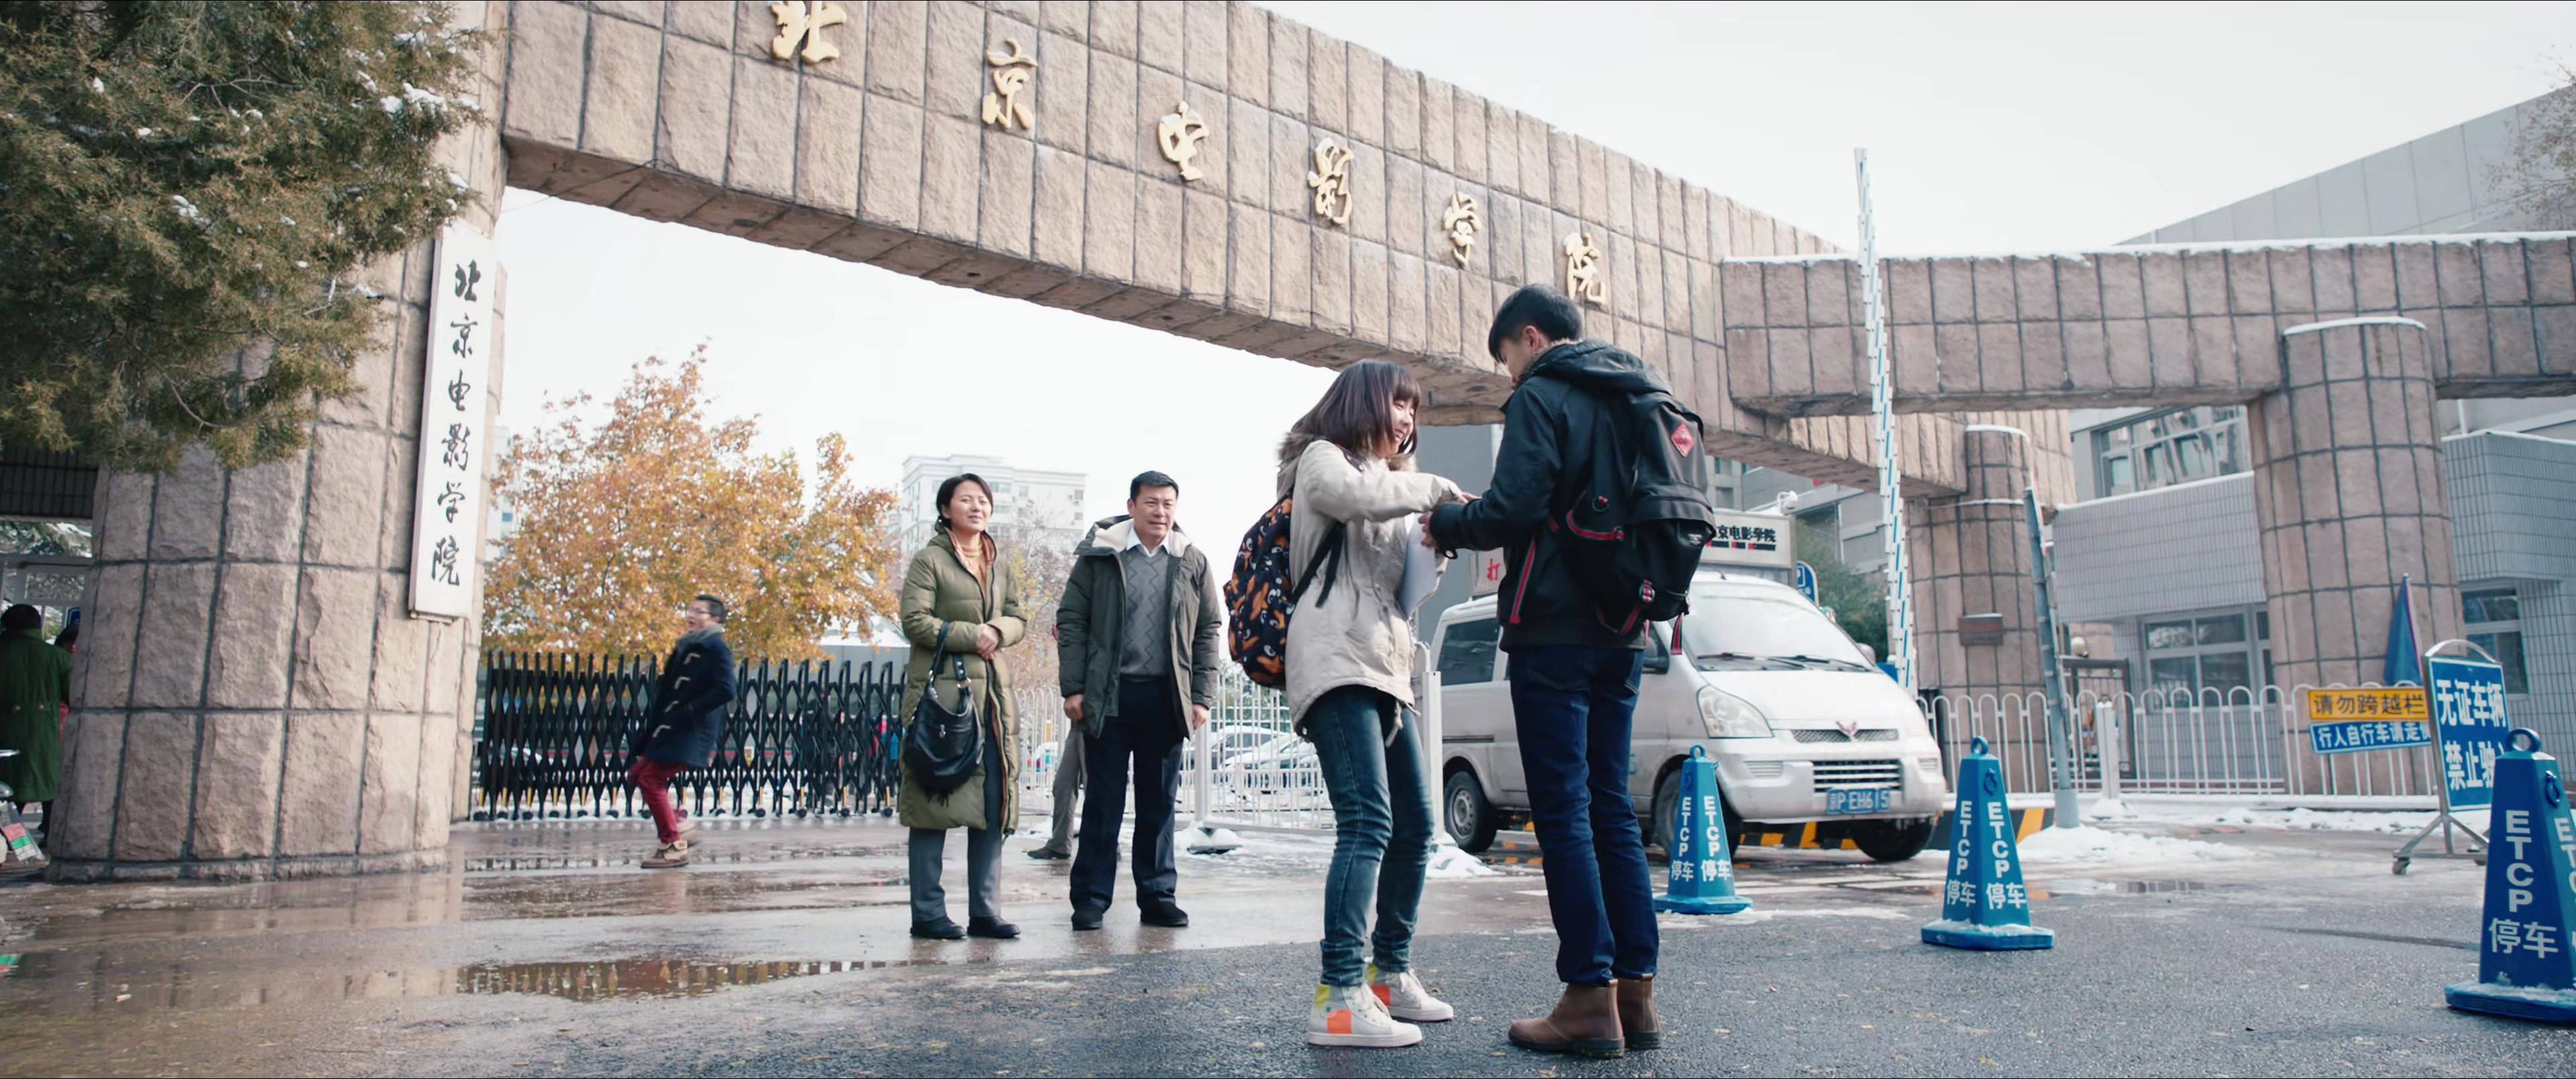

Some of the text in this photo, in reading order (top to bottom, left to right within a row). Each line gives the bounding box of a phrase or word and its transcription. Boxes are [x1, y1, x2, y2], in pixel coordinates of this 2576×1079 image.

[431, 260, 481, 586] 北京电影学院
[2314, 694, 2425, 715] 请勿跨越栏
[2436, 679, 2506, 727] 无证车辆
[1678, 797, 1691, 857] ETCP
[1704, 796, 1720, 857] ETCP
[1956, 801, 1972, 875] ETCP
[1987, 802, 2010, 878] ETCP
[1671, 860, 1695, 882] 停车
[1701, 859, 1731, 882] 停车
[2506, 810, 2534, 912] ETCP
[1947, 879, 1976, 907] 停车
[1986, 882, 2027, 910] 停车
[2489, 918, 2559, 958] 停车
